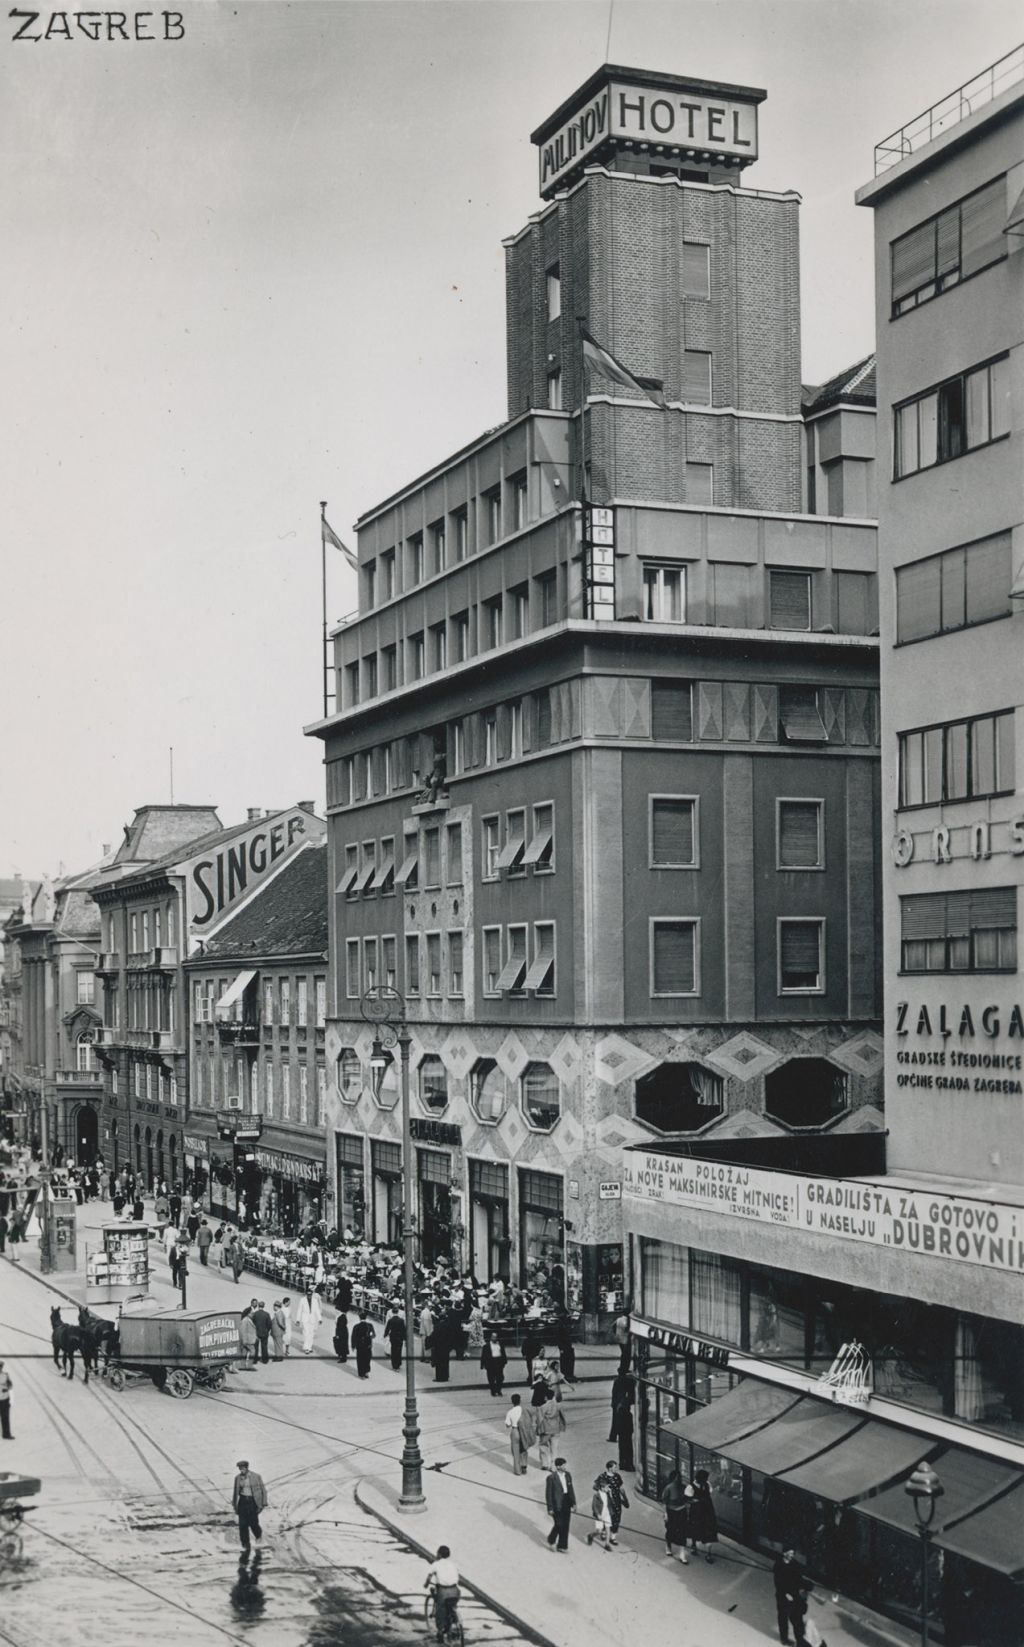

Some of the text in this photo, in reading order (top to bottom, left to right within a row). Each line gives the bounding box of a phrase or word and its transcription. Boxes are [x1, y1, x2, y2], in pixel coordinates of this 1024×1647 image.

[542, 94, 608, 183] MILINOV
[619, 93, 750, 147] HOTEL
[597, 509, 609, 602] HOTEL
[192, 816, 306, 925] SINGER
[896, 1003, 1024, 1039] ZALAGA
[896, 1050, 1022, 1071] GRADSKE ŠTEDIONICE
[935, 1076, 970, 1091] GRADA
[974, 1077, 1023, 1095] ZAGREBA
[624, 1168, 794, 1213] ZA NOVE MAKSIMIRSKE MITNICE!
[646, 1157, 749, 1187] KRASAN POLOŽAJ
[806, 1210, 813, 1225] U
[820, 1212, 876, 1238] NASELJU
[807, 1183, 892, 1216] GRADILIŠTA
[899, 1198, 918, 1220] ZA
[929, 1202, 999, 1234] GOTOVO
